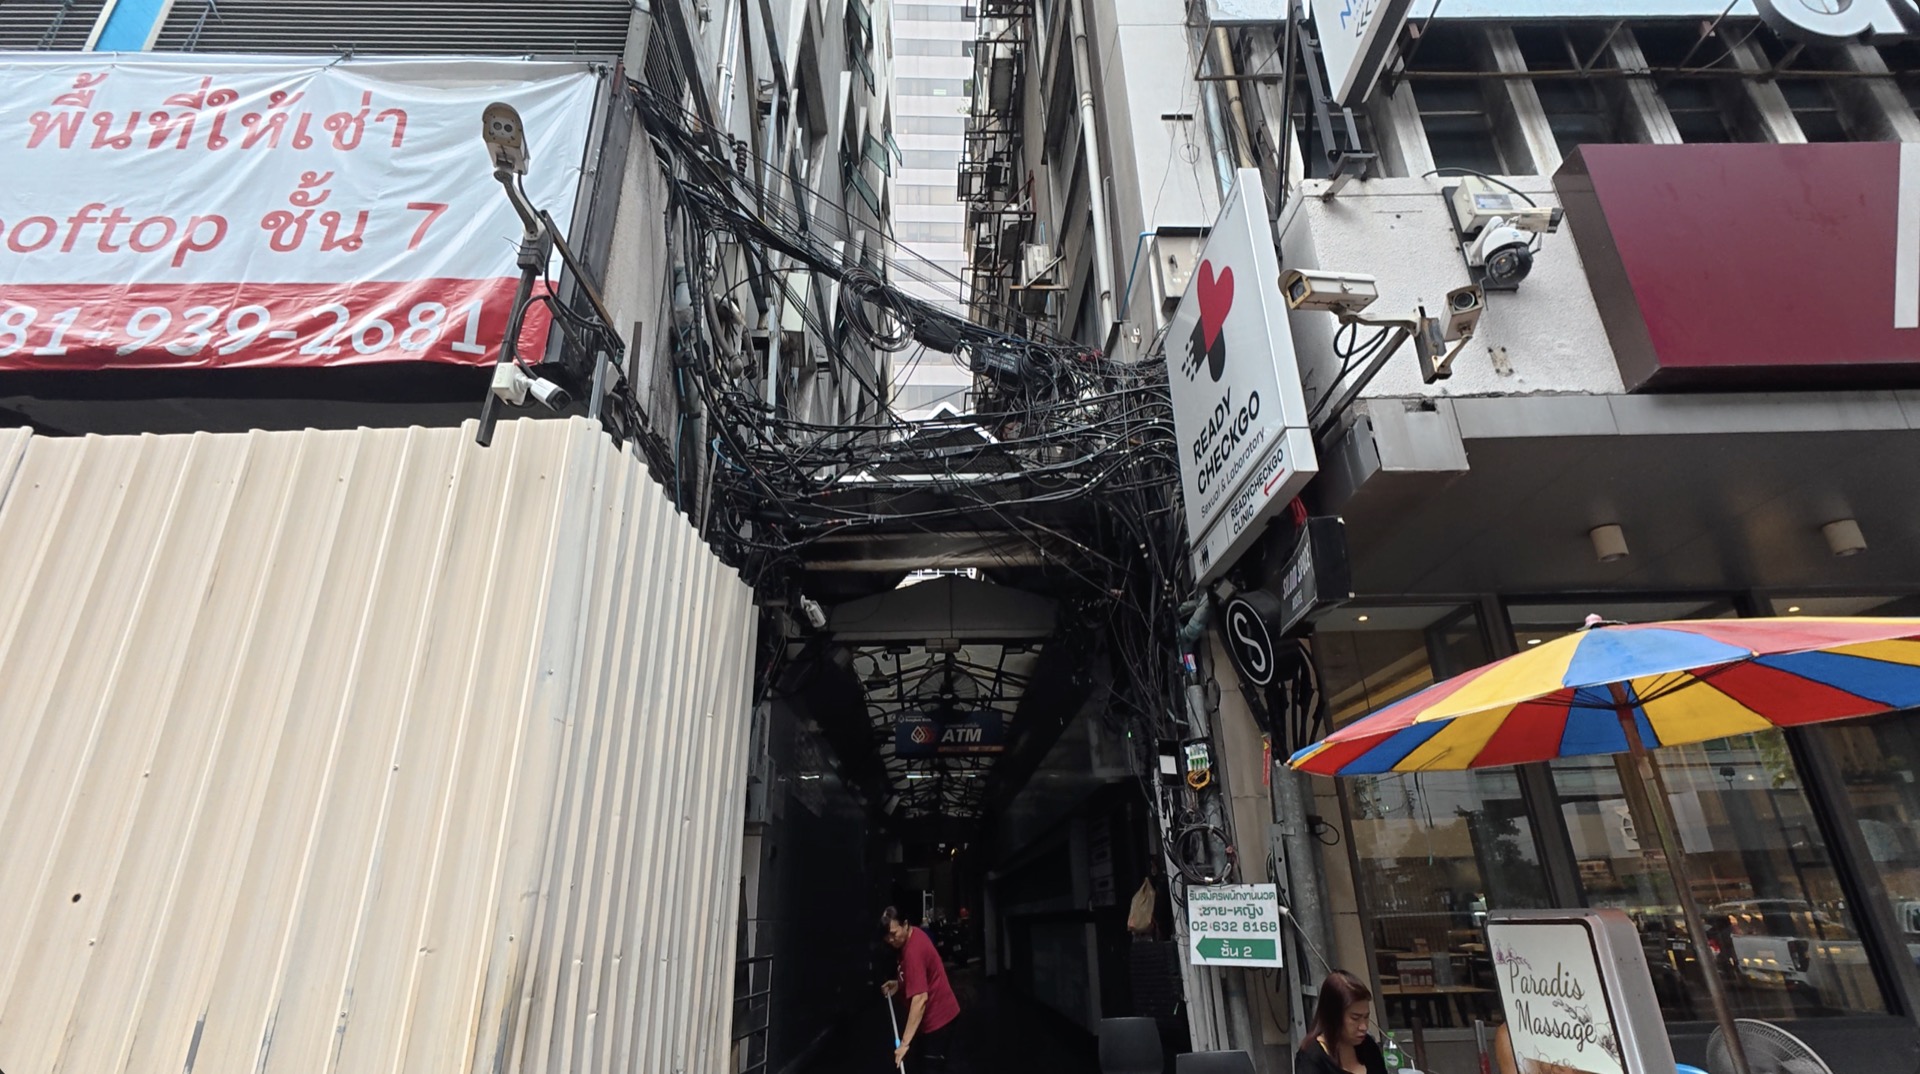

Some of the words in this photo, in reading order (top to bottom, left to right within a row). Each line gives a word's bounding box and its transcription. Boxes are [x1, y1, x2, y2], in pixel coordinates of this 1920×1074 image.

[26, 72, 408, 151] พื้นที่ให้เช่า
[260, 171, 369, 252] ชั้น
[406, 202, 448, 251] 7
[1193, 386, 1231, 465] READY
[1197, 390, 1260, 495] CHECKGO
[1201, 484, 1221, 518] Sexual
[1220, 480, 1227, 493] &
[1226, 426, 1266, 482] Laboratory
[1230, 448, 1284, 521] READYCHECKGO
[1233, 504, 1255, 536] CLINIC
[1232, 611, 1267, 674] S
[940, 728, 983, 743] ATM
[1189, 889, 1276, 901] รับสมัครพนักงานนวด
[1202, 903, 1264, 919] ชาย-หญิง
[1191, 921, 1208, 932] 02
[1212, 921, 1238, 932] 632
[1242, 921, 1278, 932] 8168
[1220, 940, 1239, 957] ชั้น
[1243, 946, 1253, 957] 2
[1507, 958, 1586, 1000] Paradis
[1515, 999, 1597, 1053] Massage
